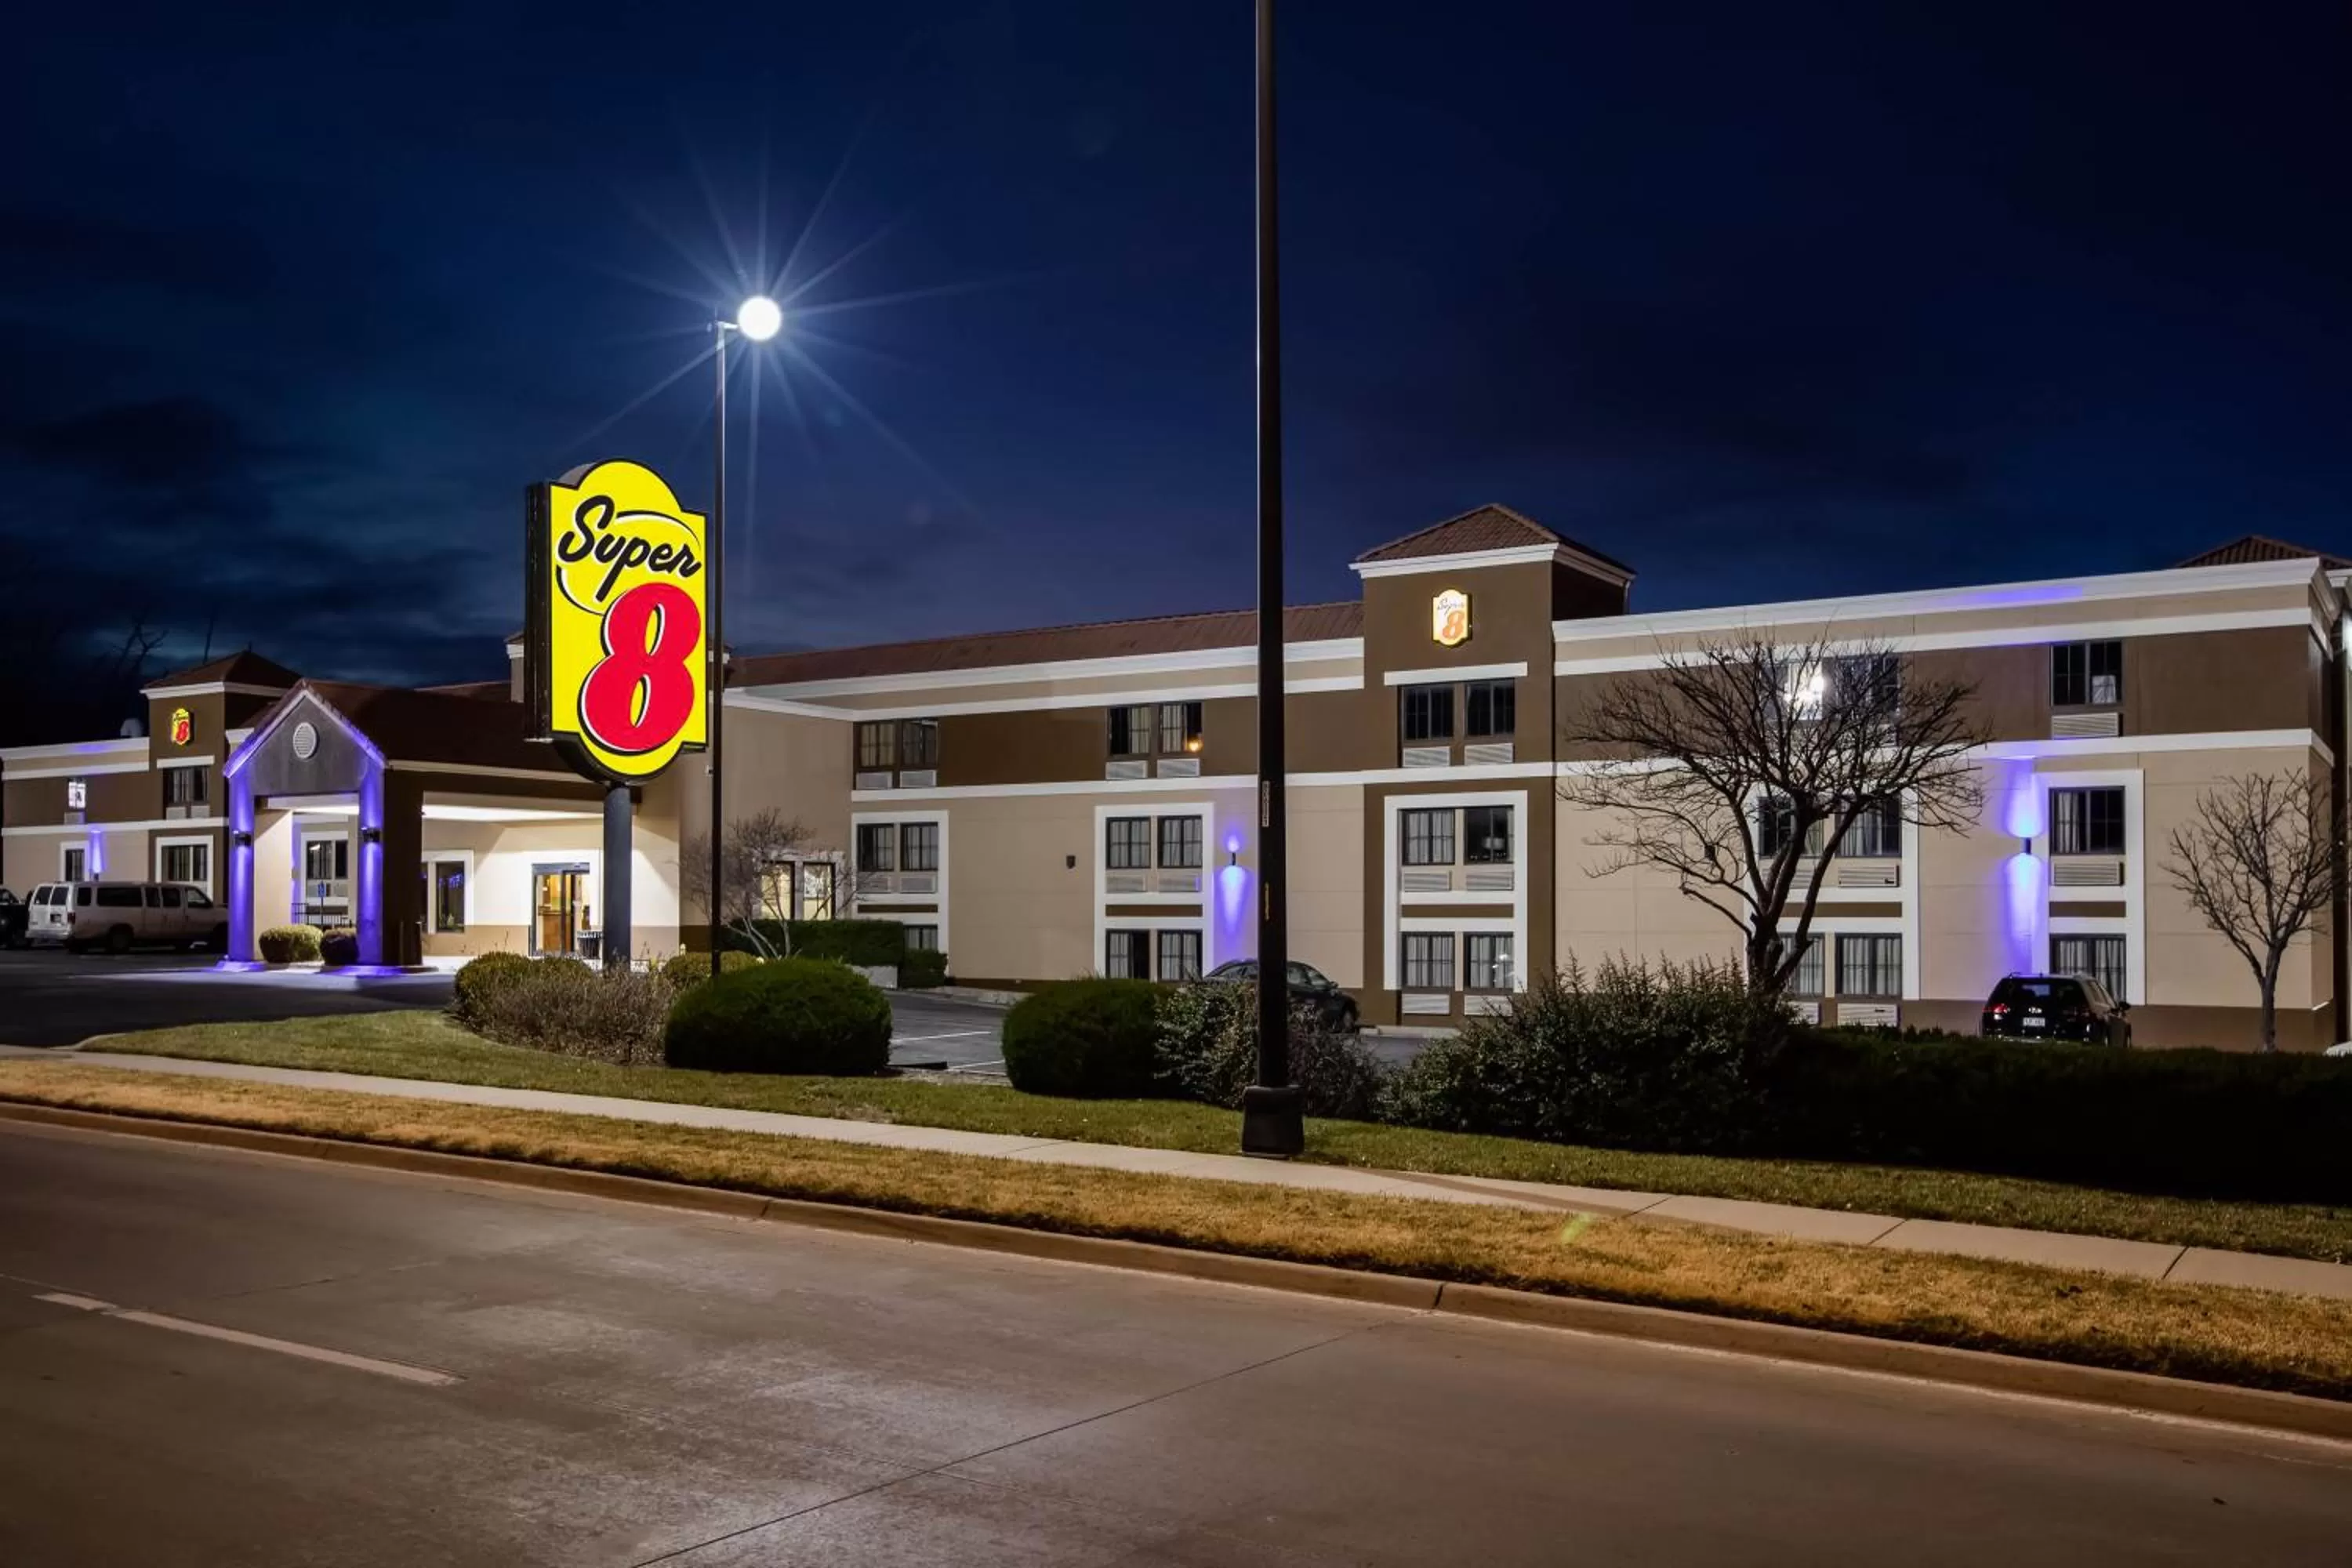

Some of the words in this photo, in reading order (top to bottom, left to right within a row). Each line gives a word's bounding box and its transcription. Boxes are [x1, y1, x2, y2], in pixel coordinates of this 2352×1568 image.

[557, 495, 702, 603] Super
[578, 582, 702, 755] 8
[1443, 611, 1465, 640] 8
